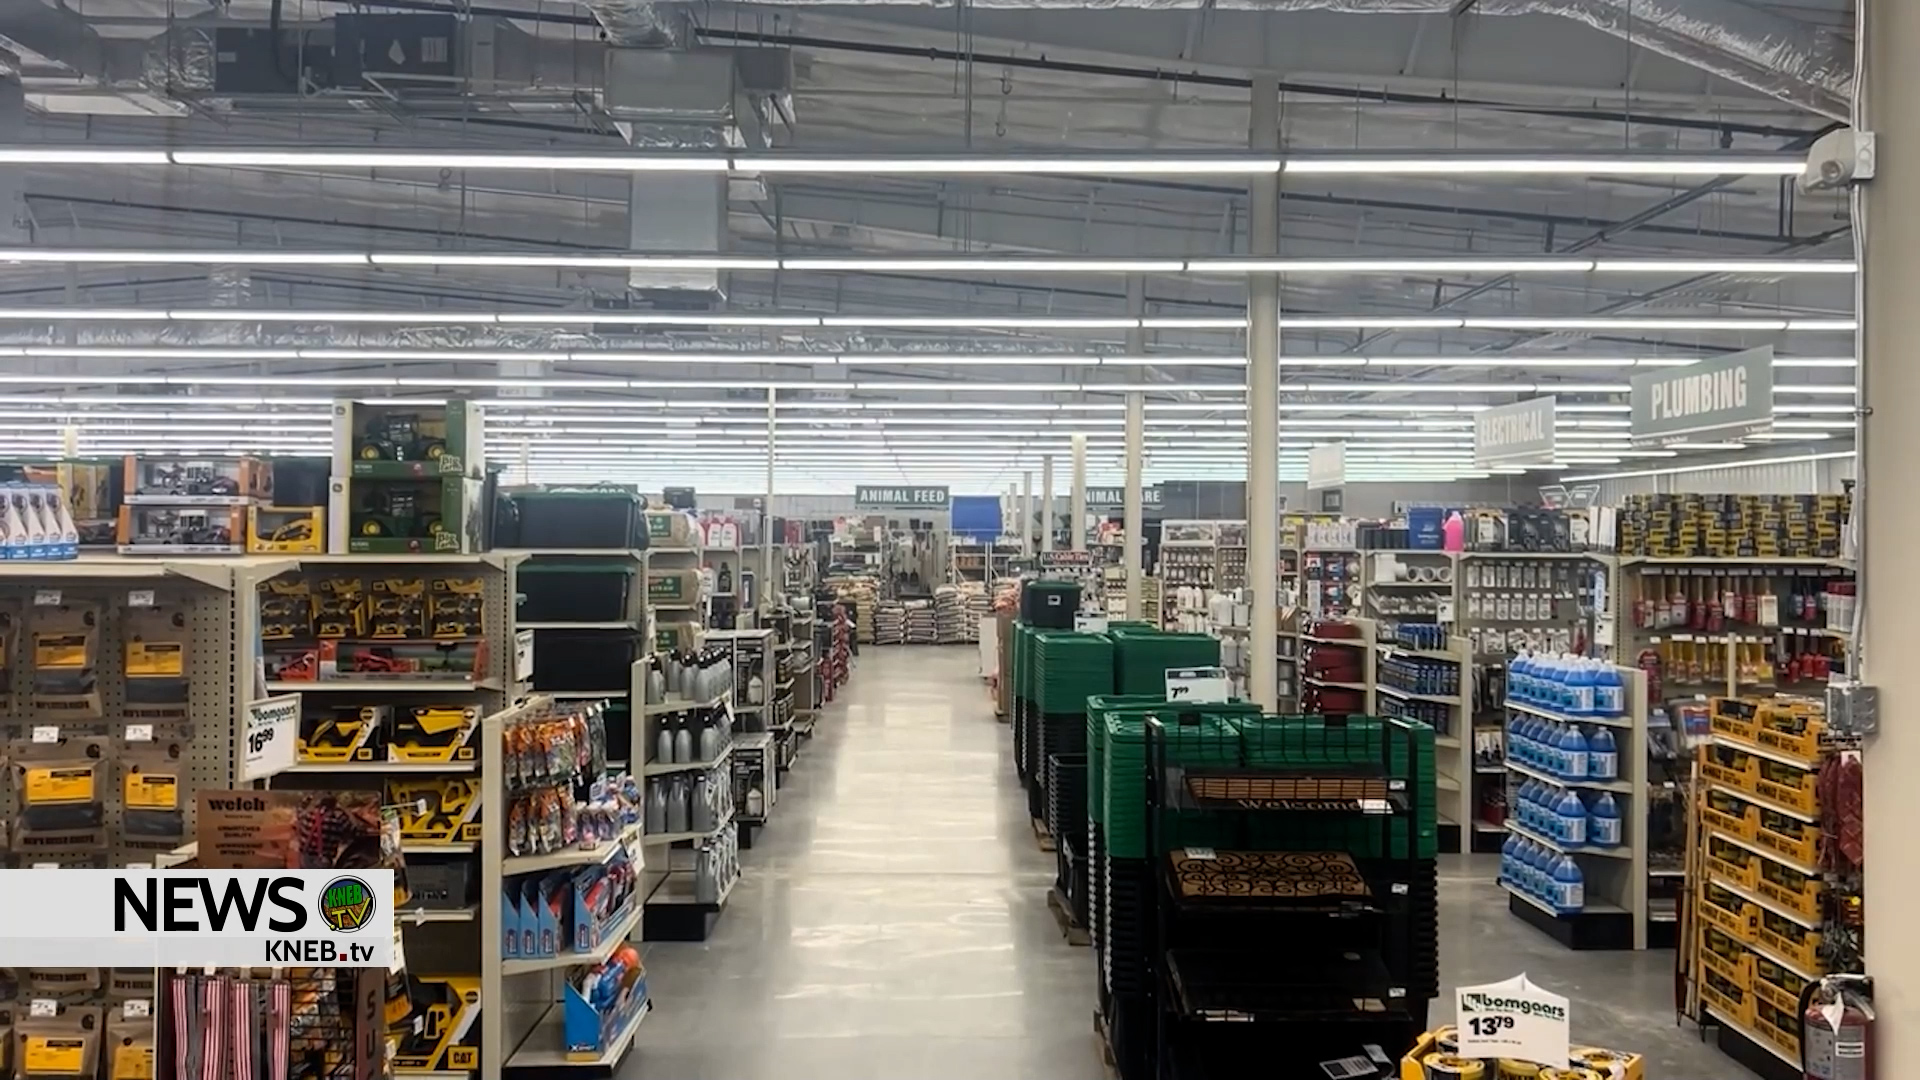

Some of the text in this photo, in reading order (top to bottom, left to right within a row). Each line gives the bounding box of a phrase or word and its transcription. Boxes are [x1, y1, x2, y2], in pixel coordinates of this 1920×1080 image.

[1652, 366, 1747, 420] PLUMBING
[1481, 408, 1545, 447] ELECTRICAL
[860, 489, 944, 502] ANIMAL FEED
[208, 797, 265, 811] welch
[1482, 994, 1565, 1018] bomgaars
[453, 1051, 473, 1063] CAT
